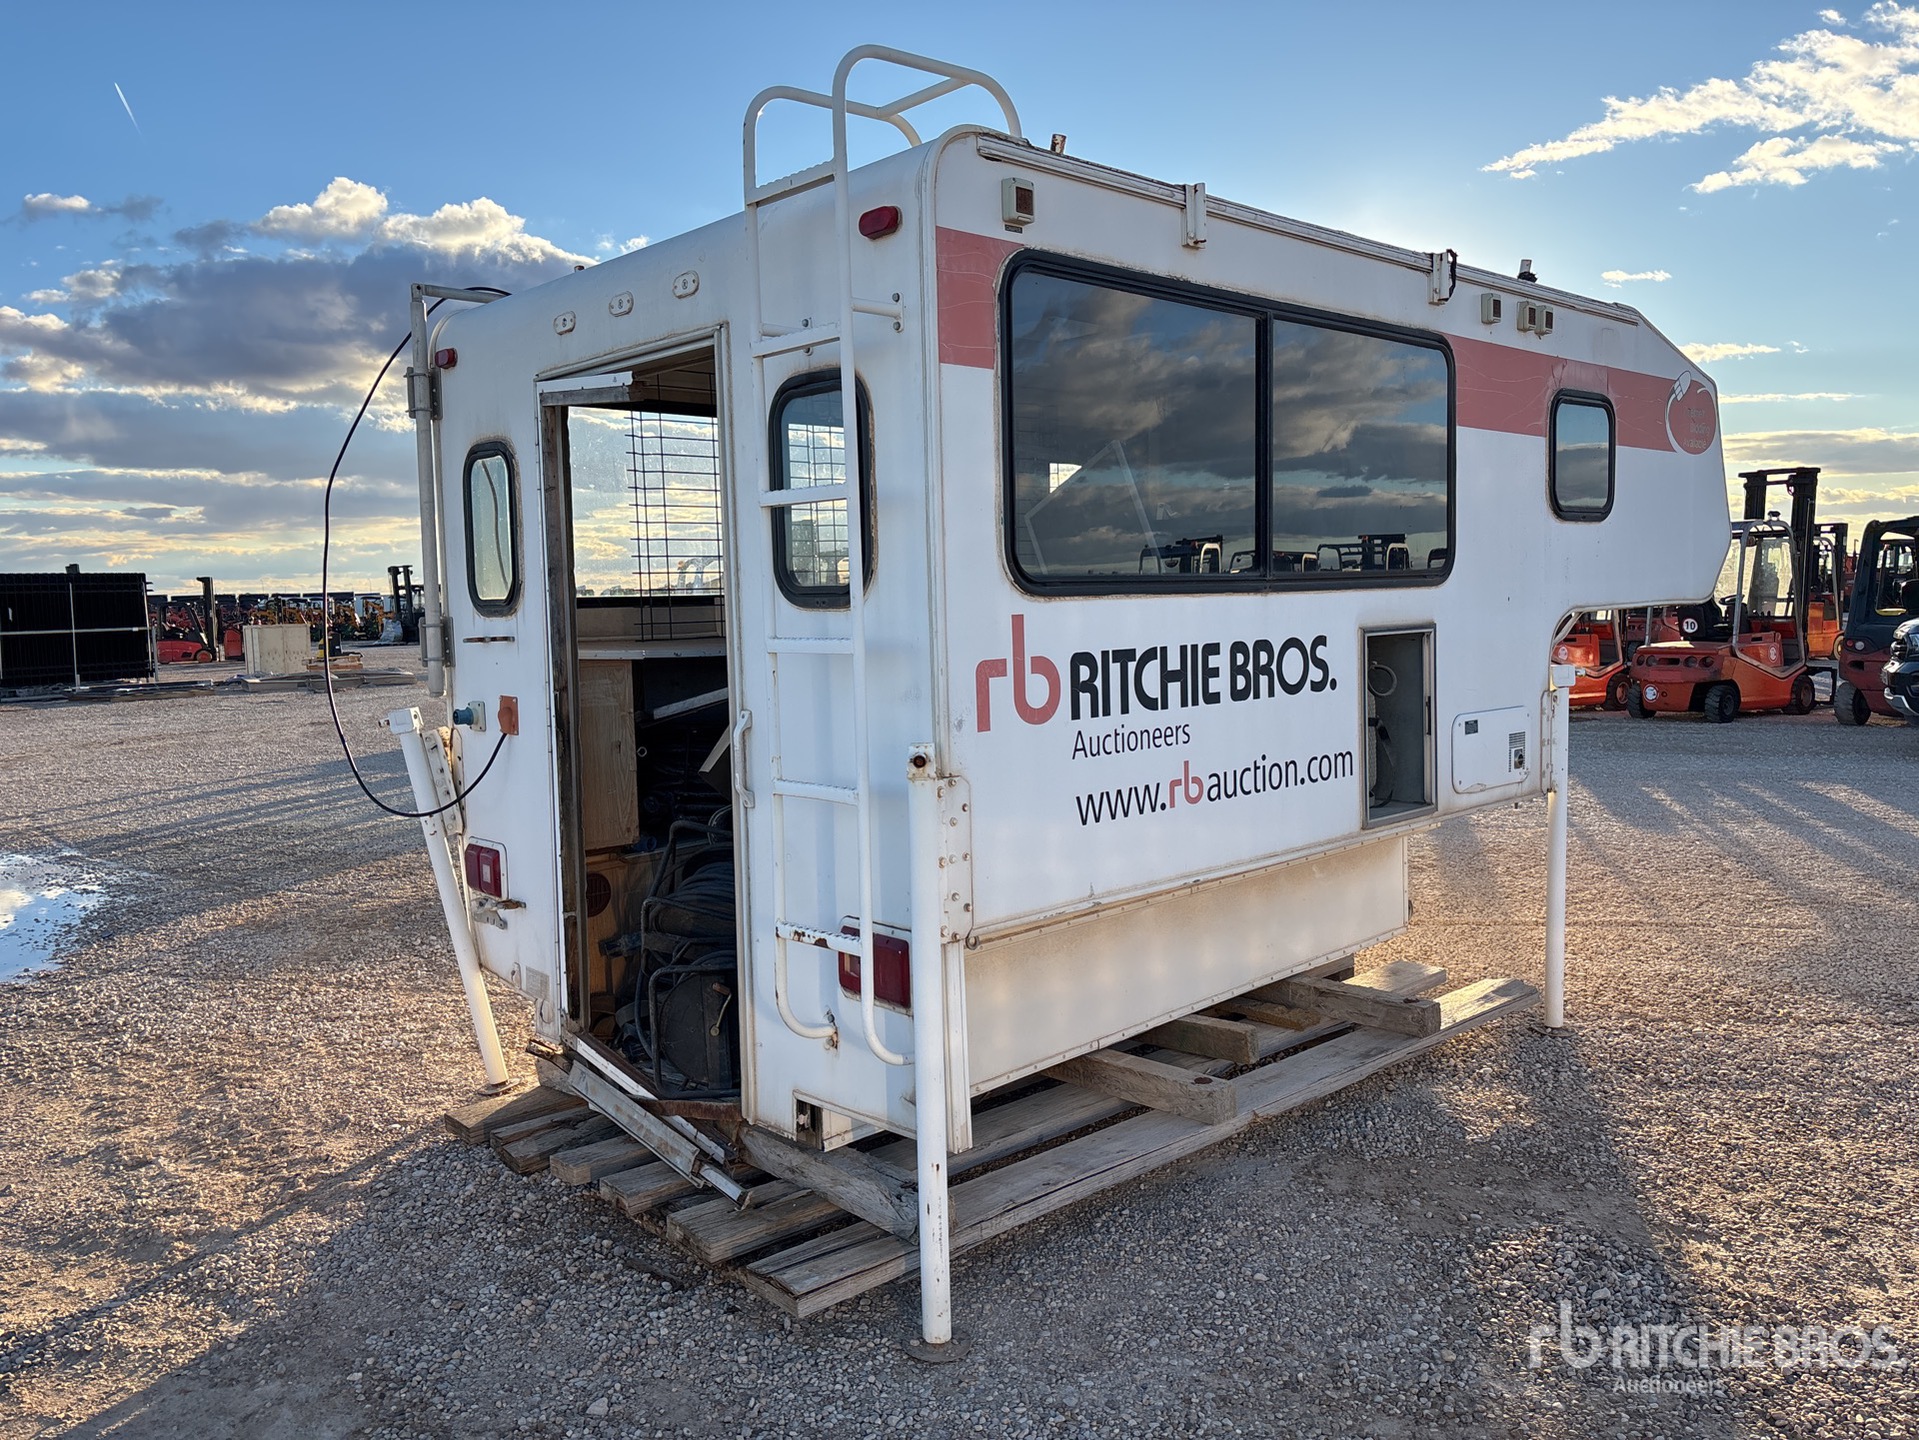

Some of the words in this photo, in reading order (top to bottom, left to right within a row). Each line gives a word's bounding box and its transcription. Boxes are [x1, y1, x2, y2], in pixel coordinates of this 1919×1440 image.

[1686, 620, 1696, 630] 10
[975, 614, 1061, 732] rb
[1070, 642, 1221, 720] RITCHIE
[1229, 634, 1338, 702] BROS.
[1072, 723, 1191, 760] Auctioneers
[1075, 750, 1354, 826] www.rbauction.com
